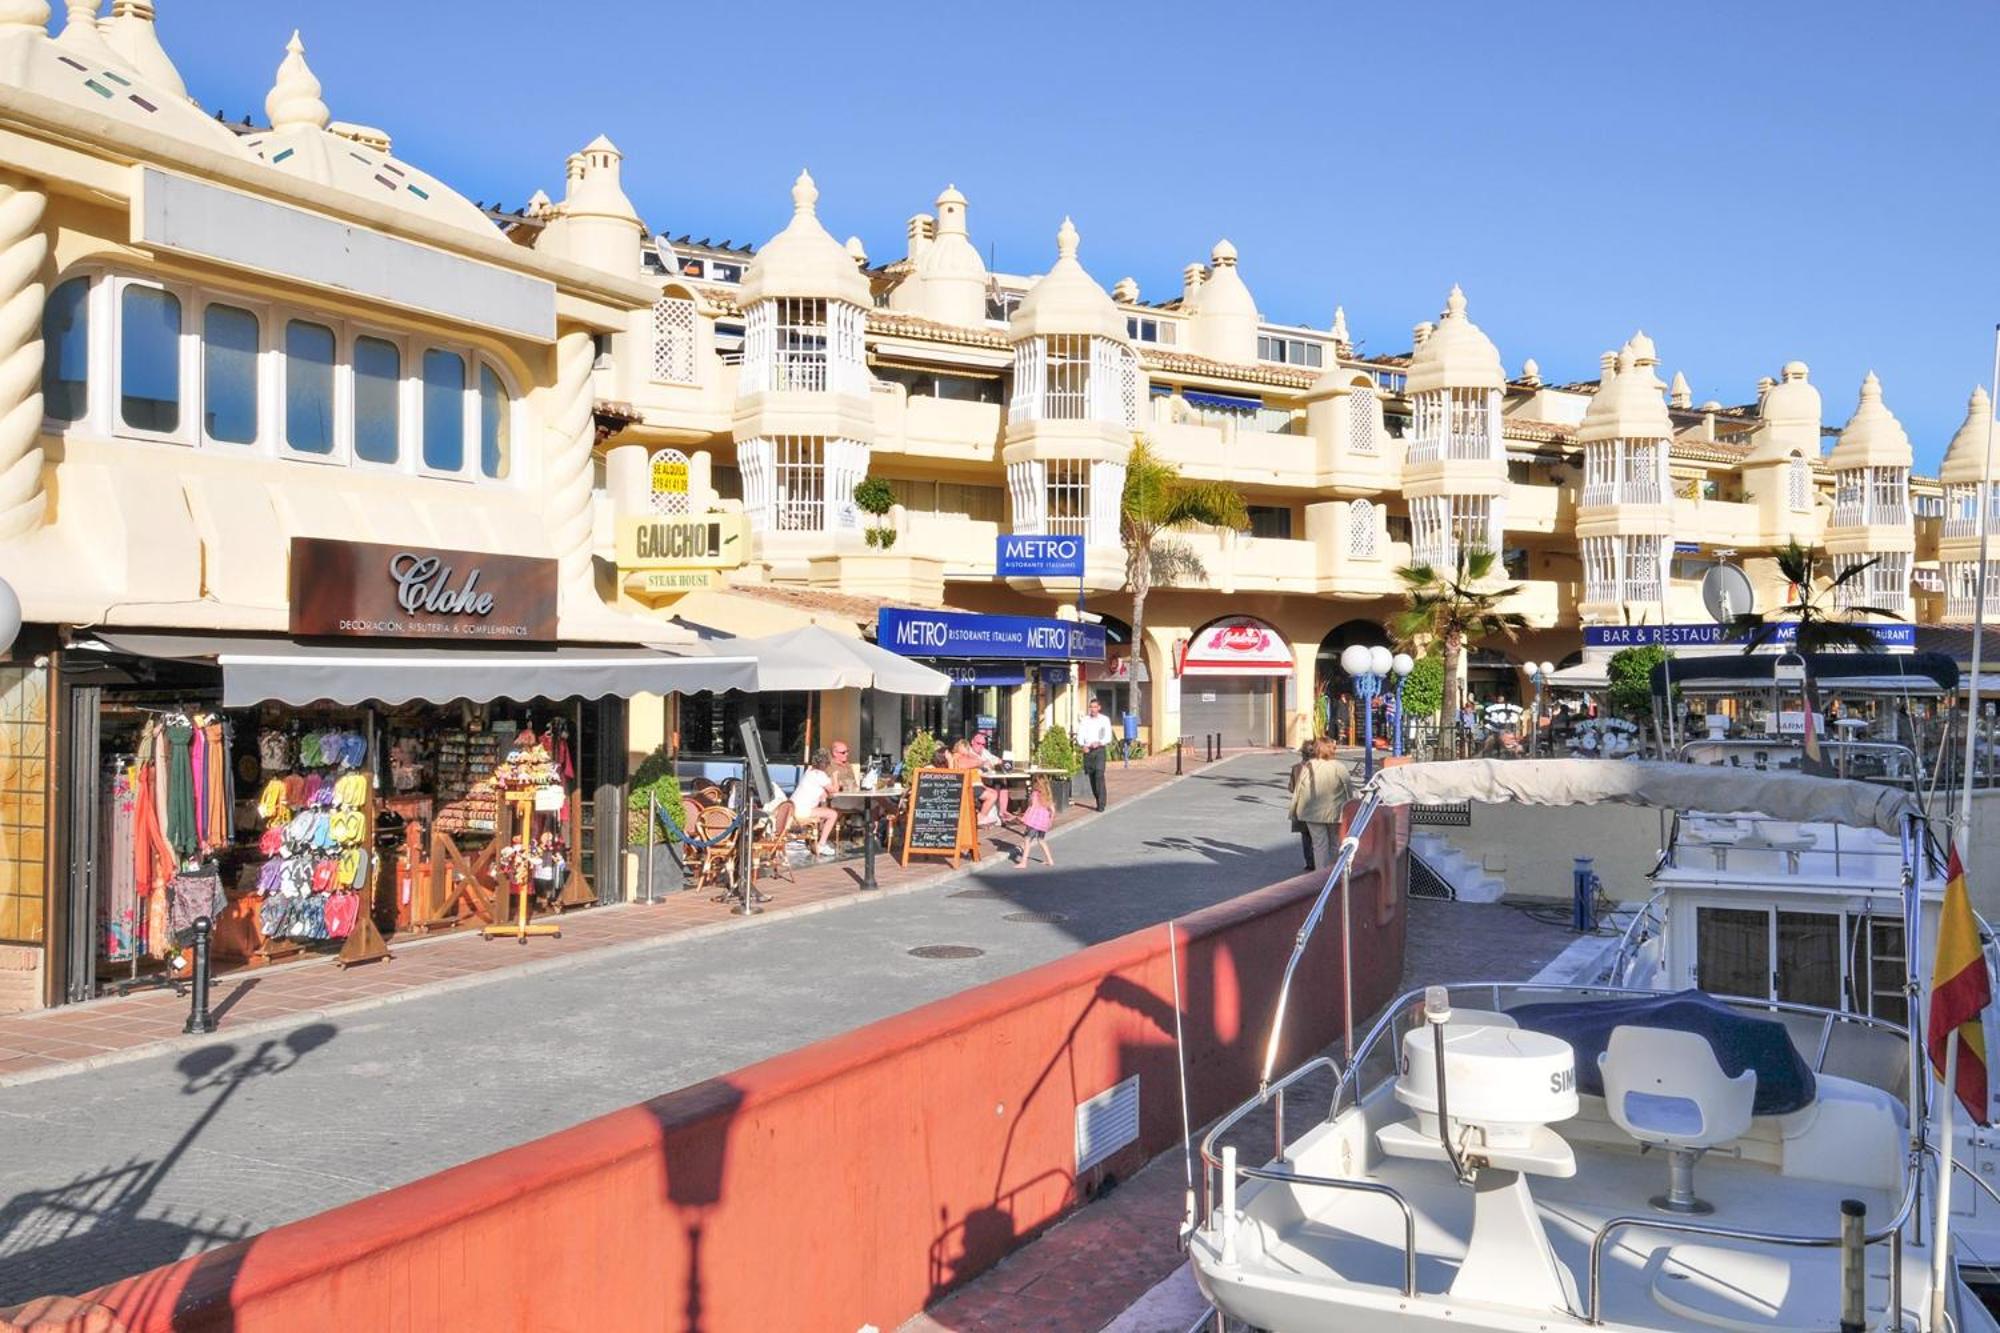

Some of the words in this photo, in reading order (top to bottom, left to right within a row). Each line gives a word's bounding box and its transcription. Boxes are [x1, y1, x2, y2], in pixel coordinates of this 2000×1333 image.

[662, 464, 687, 476] ALQUILA
[636, 523, 706, 559] GAUCHO
[1005, 540, 1076, 559] METRO
[390, 552, 494, 616] Clohe
[648, 574, 677, 587] STEAK
[679, 574, 709, 587] HOUSE
[462, 624, 528, 635] COMPLEMENTOS
[896, 619, 946, 647] METRO
[948, 629, 991, 642] RISTORANTE
[991, 631, 1023, 643] ITALIANO
[1027, 626, 1065, 650] METRO
[1603, 629, 1631, 642] BAR
[1636, 629, 1646, 642] &
[1652, 627, 1758, 642] RESTAURAT
